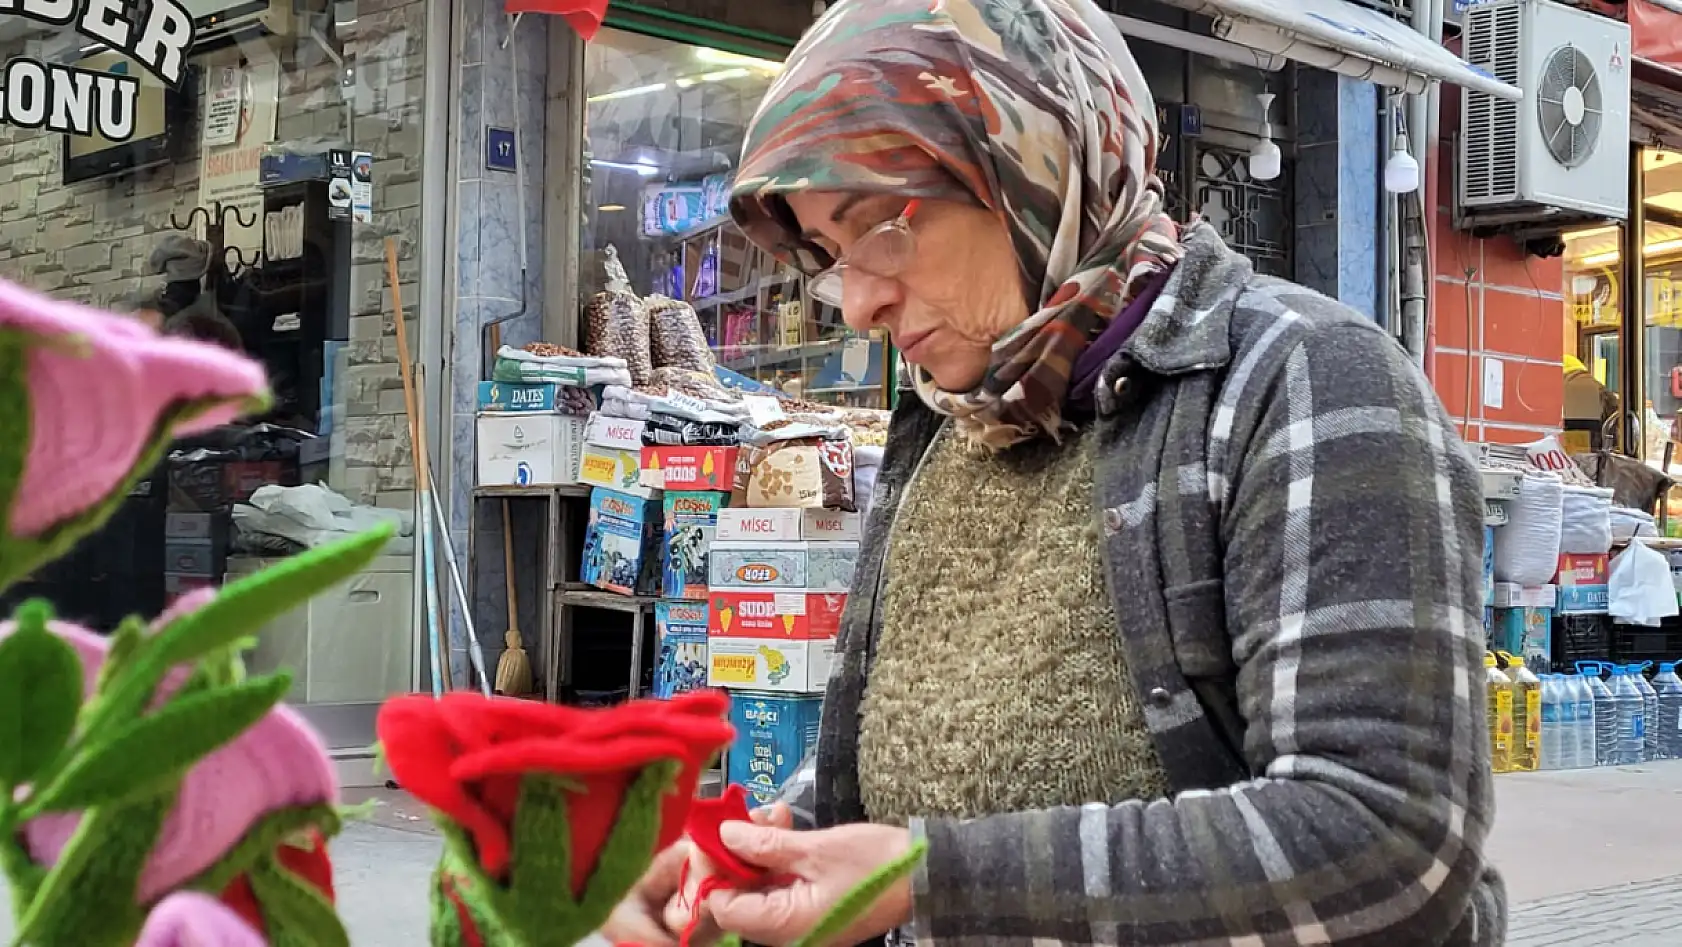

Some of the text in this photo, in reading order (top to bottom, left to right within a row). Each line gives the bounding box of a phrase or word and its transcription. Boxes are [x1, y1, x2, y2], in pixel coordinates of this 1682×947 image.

[0, 59, 139, 141] ONU
[497, 141, 511, 157] 17
[512, 388, 544, 403] DATES
[744, 567, 771, 581] EFOR
[738, 601, 776, 618] SUDE
